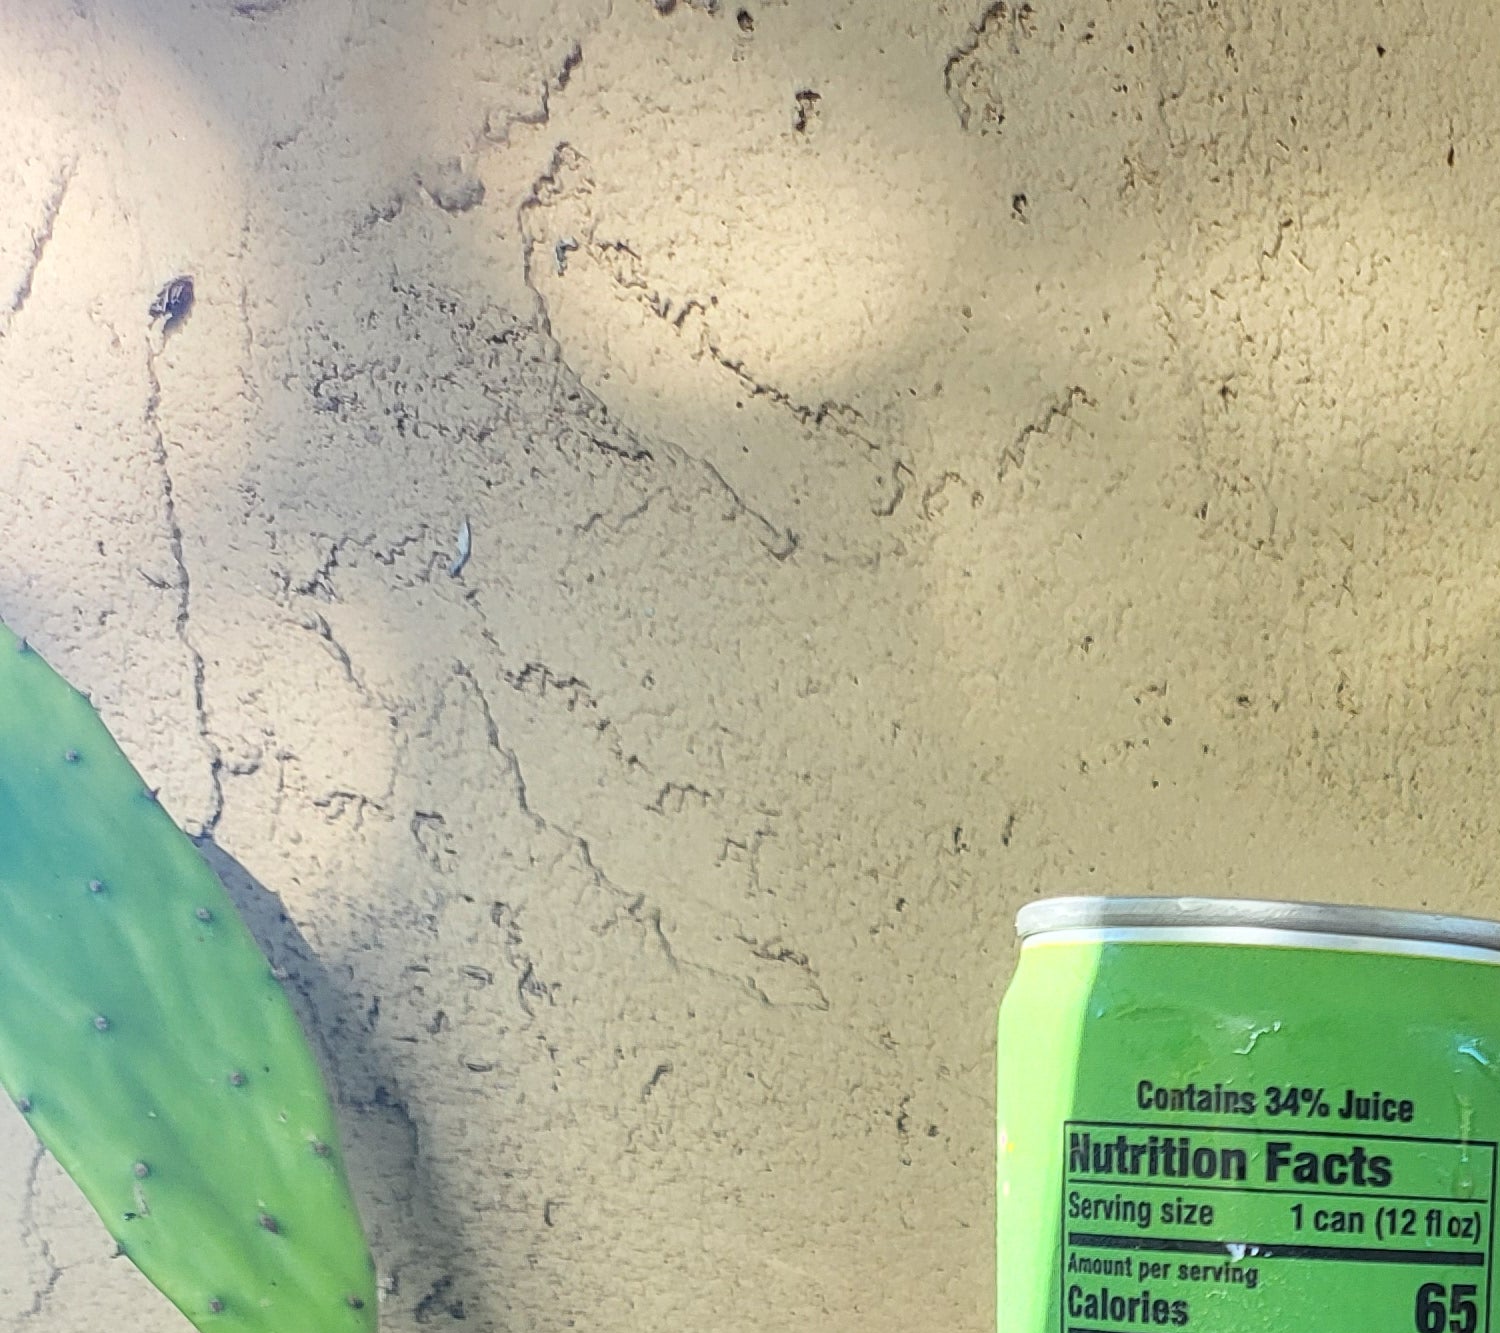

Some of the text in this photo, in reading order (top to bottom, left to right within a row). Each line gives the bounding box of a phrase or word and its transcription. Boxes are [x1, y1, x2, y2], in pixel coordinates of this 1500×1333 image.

[1138, 1080, 1414, 1122] Contains 34% Juice
[1070, 1132, 1392, 1187] Nutrition Facts
[1069, 1192, 1481, 1244] Serving size 1 can (12 fl oz)
[1068, 1252, 1258, 1289] Amount per serving
[1068, 1285, 1189, 1326] Calories
